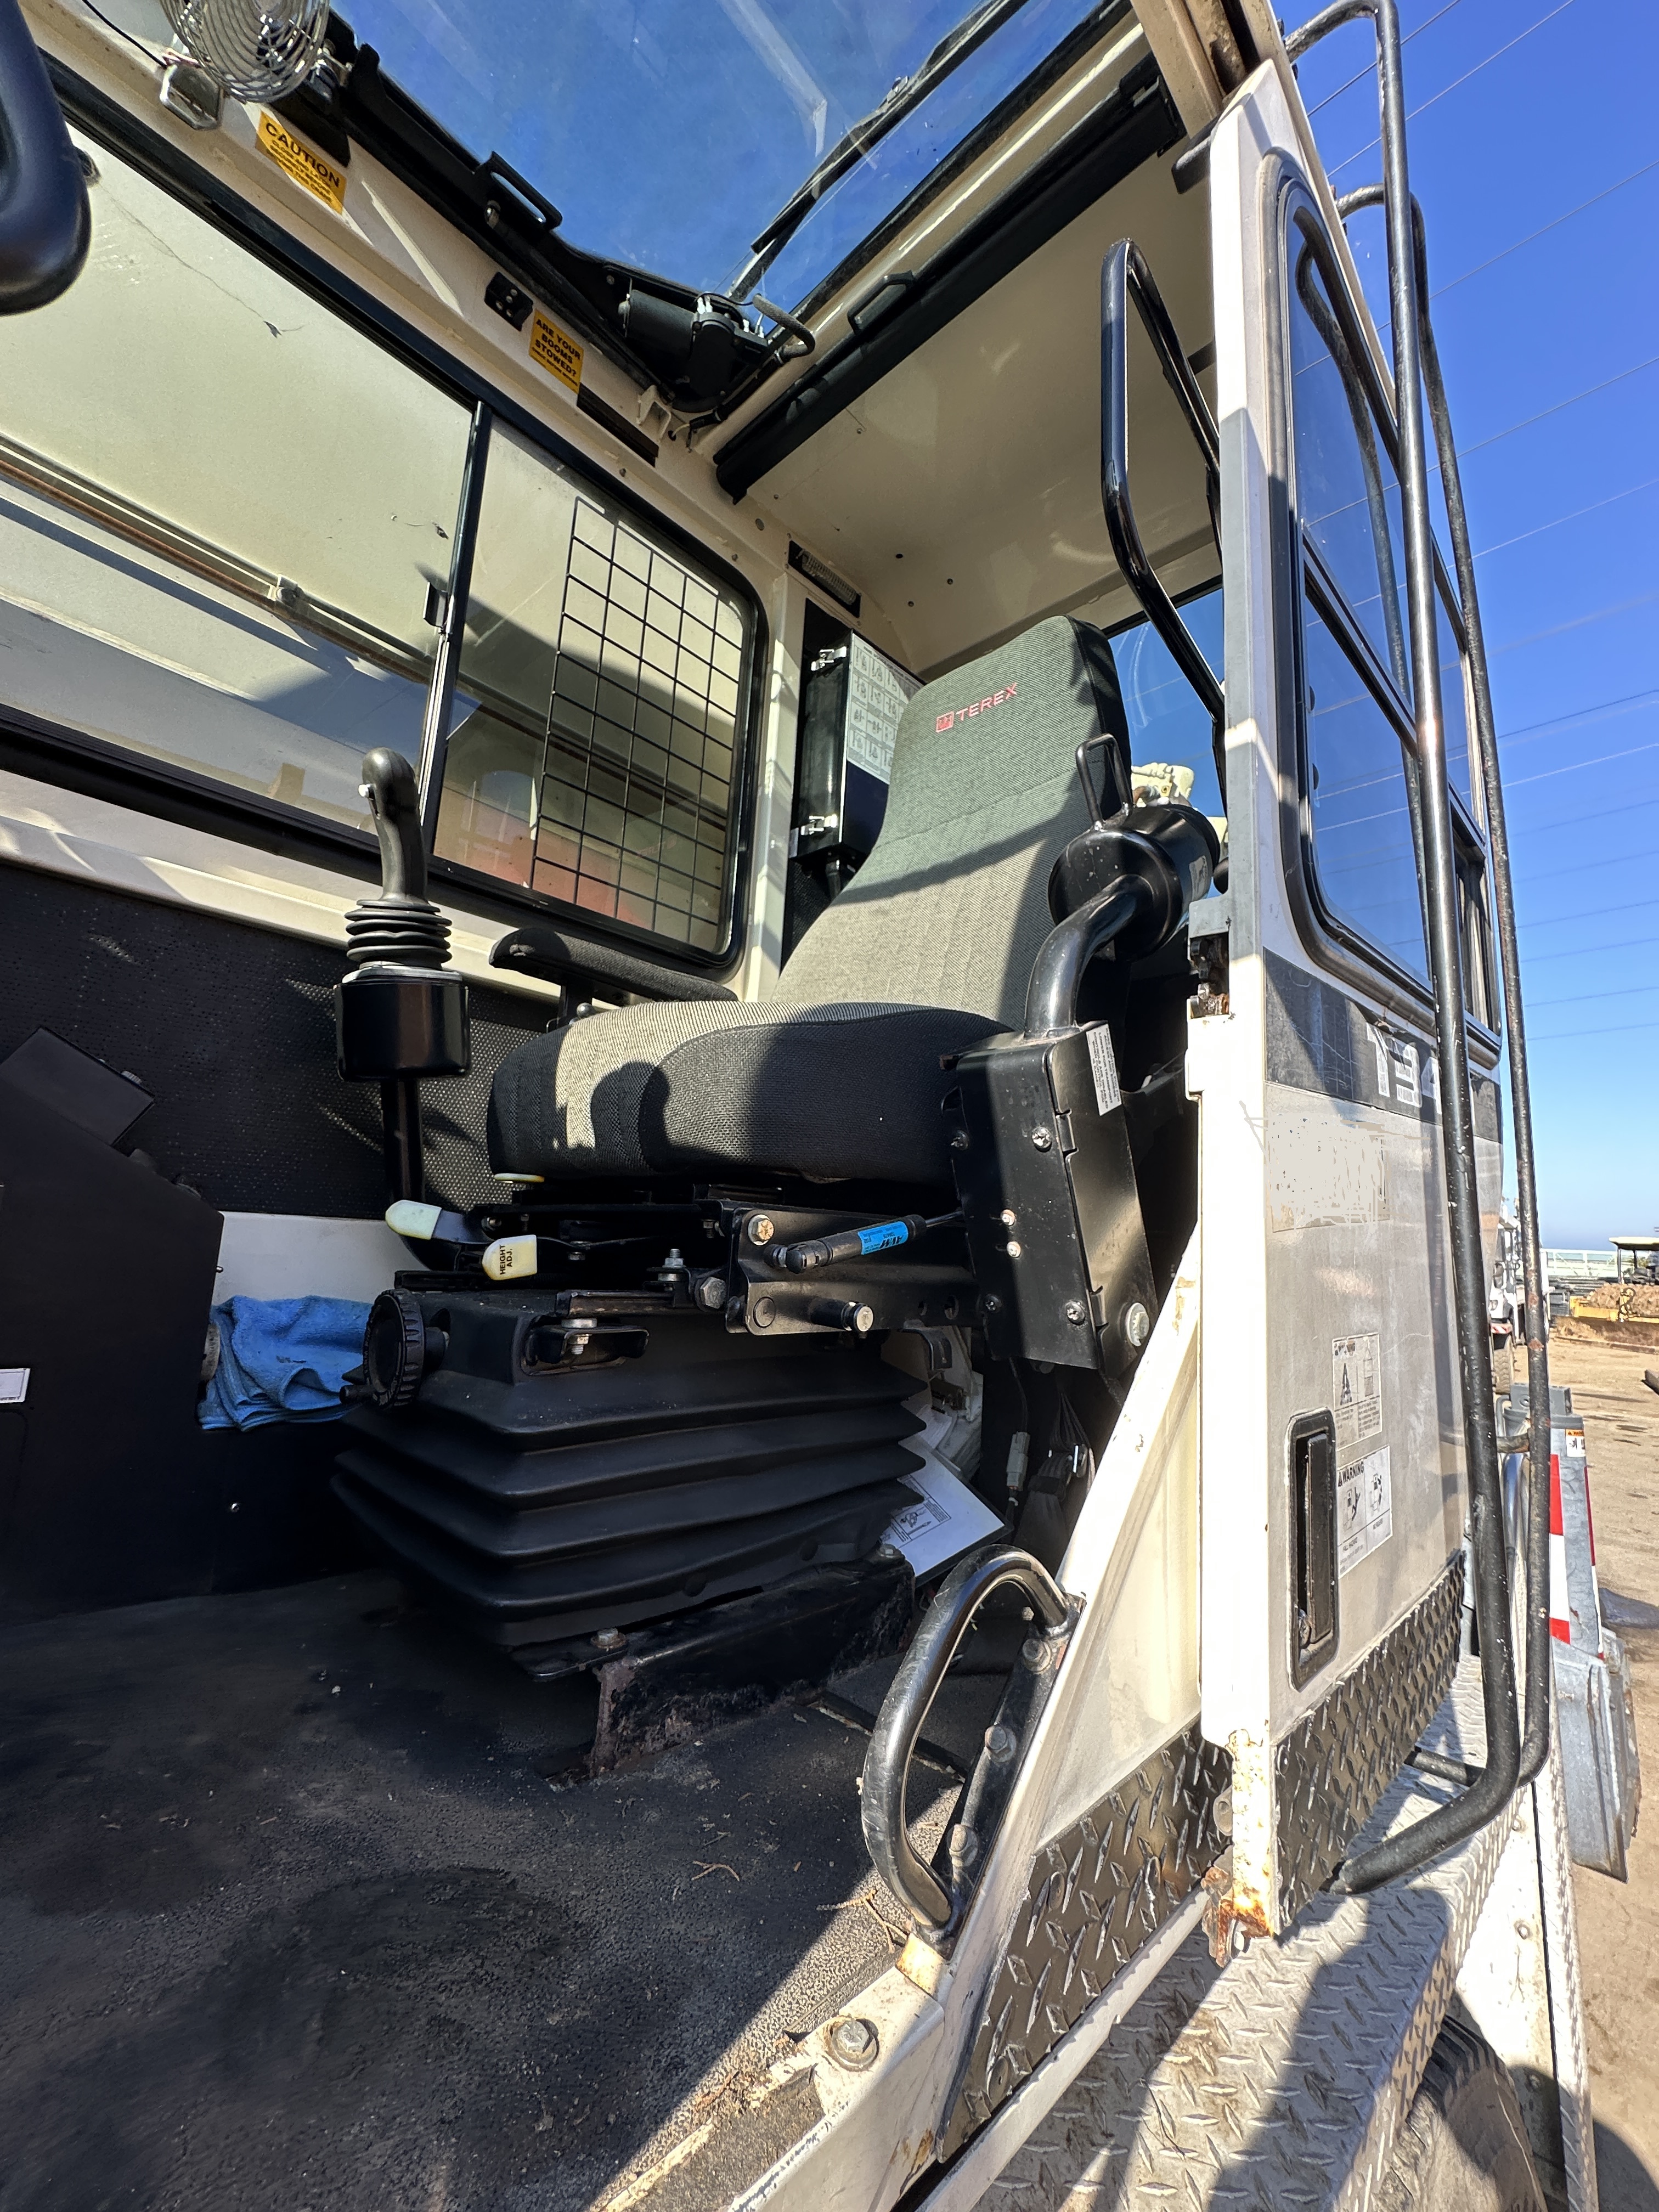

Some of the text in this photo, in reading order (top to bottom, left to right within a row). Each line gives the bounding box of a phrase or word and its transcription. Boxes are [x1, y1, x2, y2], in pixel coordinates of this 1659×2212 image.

[266, 122, 340, 188] CAUTION
[535, 319, 580, 360] ARE YOUR
[535, 339, 577, 377] STOWED?
[541, 332, 573, 364] BOOMS
[956, 681, 1018, 722] TEREX
[1342, 1460, 1364, 1485] WARNING
